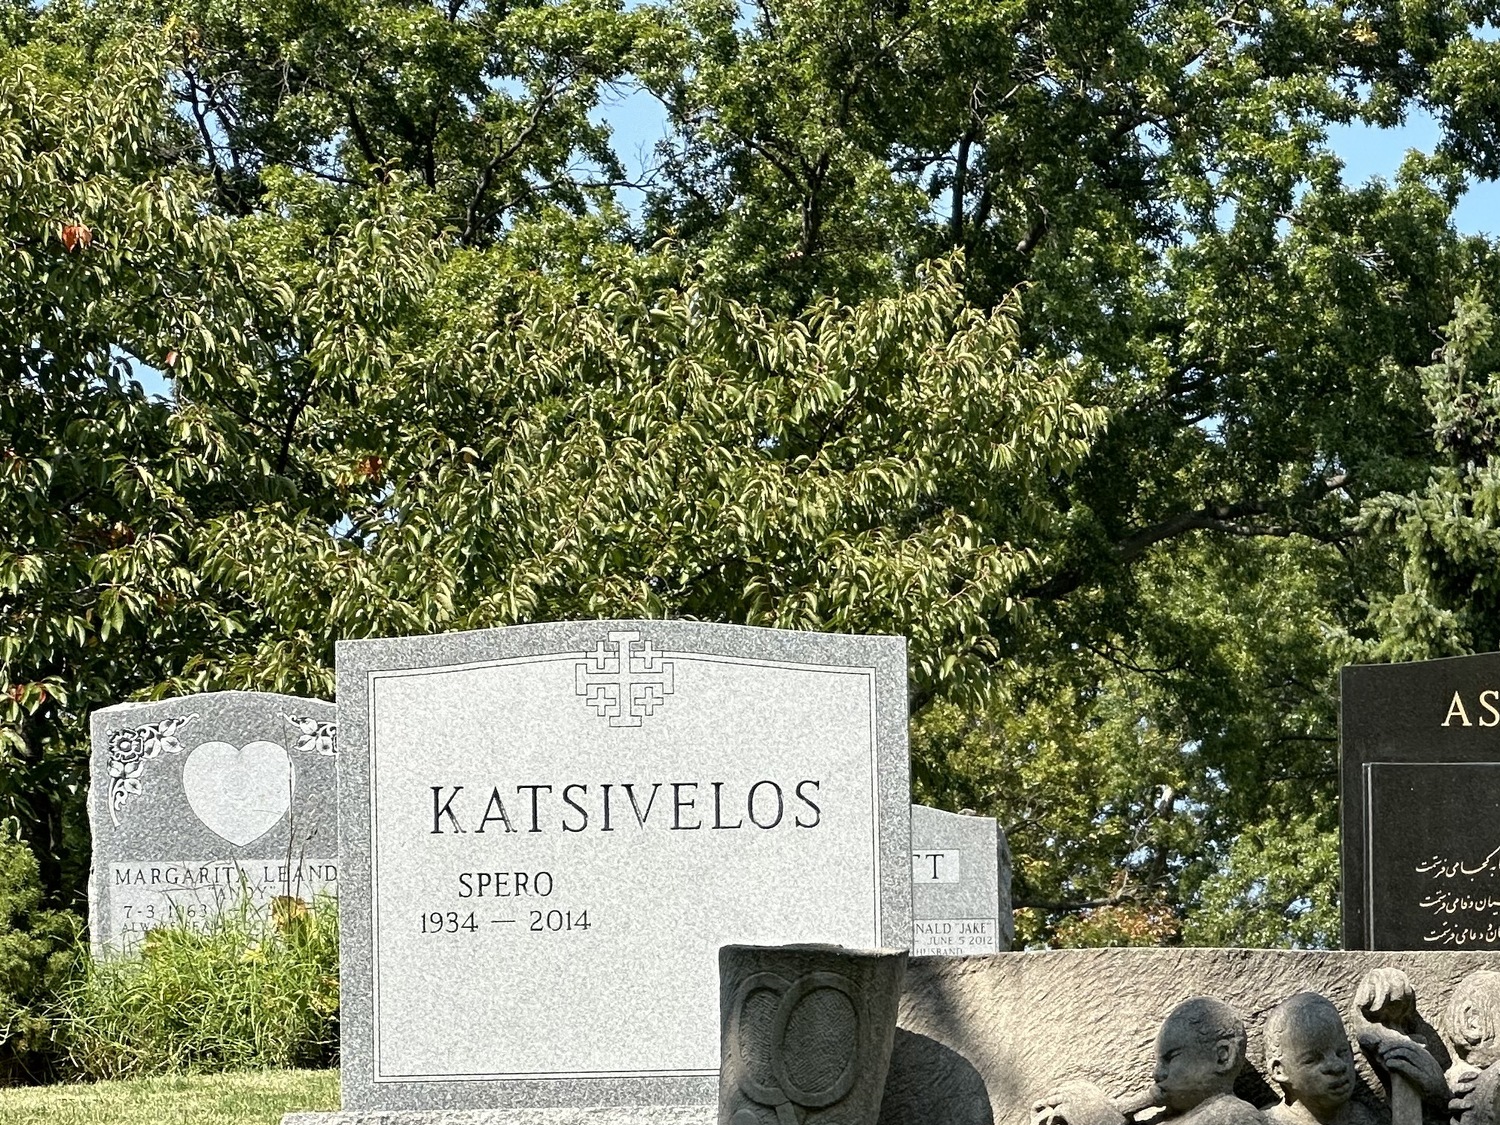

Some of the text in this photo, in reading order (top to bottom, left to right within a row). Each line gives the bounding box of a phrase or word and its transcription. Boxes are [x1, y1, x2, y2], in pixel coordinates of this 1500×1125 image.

[430, 780, 821, 834] KATSIVELOS
[115, 866, 249, 885] MARGARITA
[1460, 845, 1500, 882] کجا
[1489, 865, 1497, 877] به
[458, 871, 554, 898] SPERO
[421, 911, 479, 934] 1934
[530, 909, 592, 932] 2014
[927, 936, 954, 946] JUNE
[958, 936, 966, 945] 5
[969, 936, 993, 945] 2012
